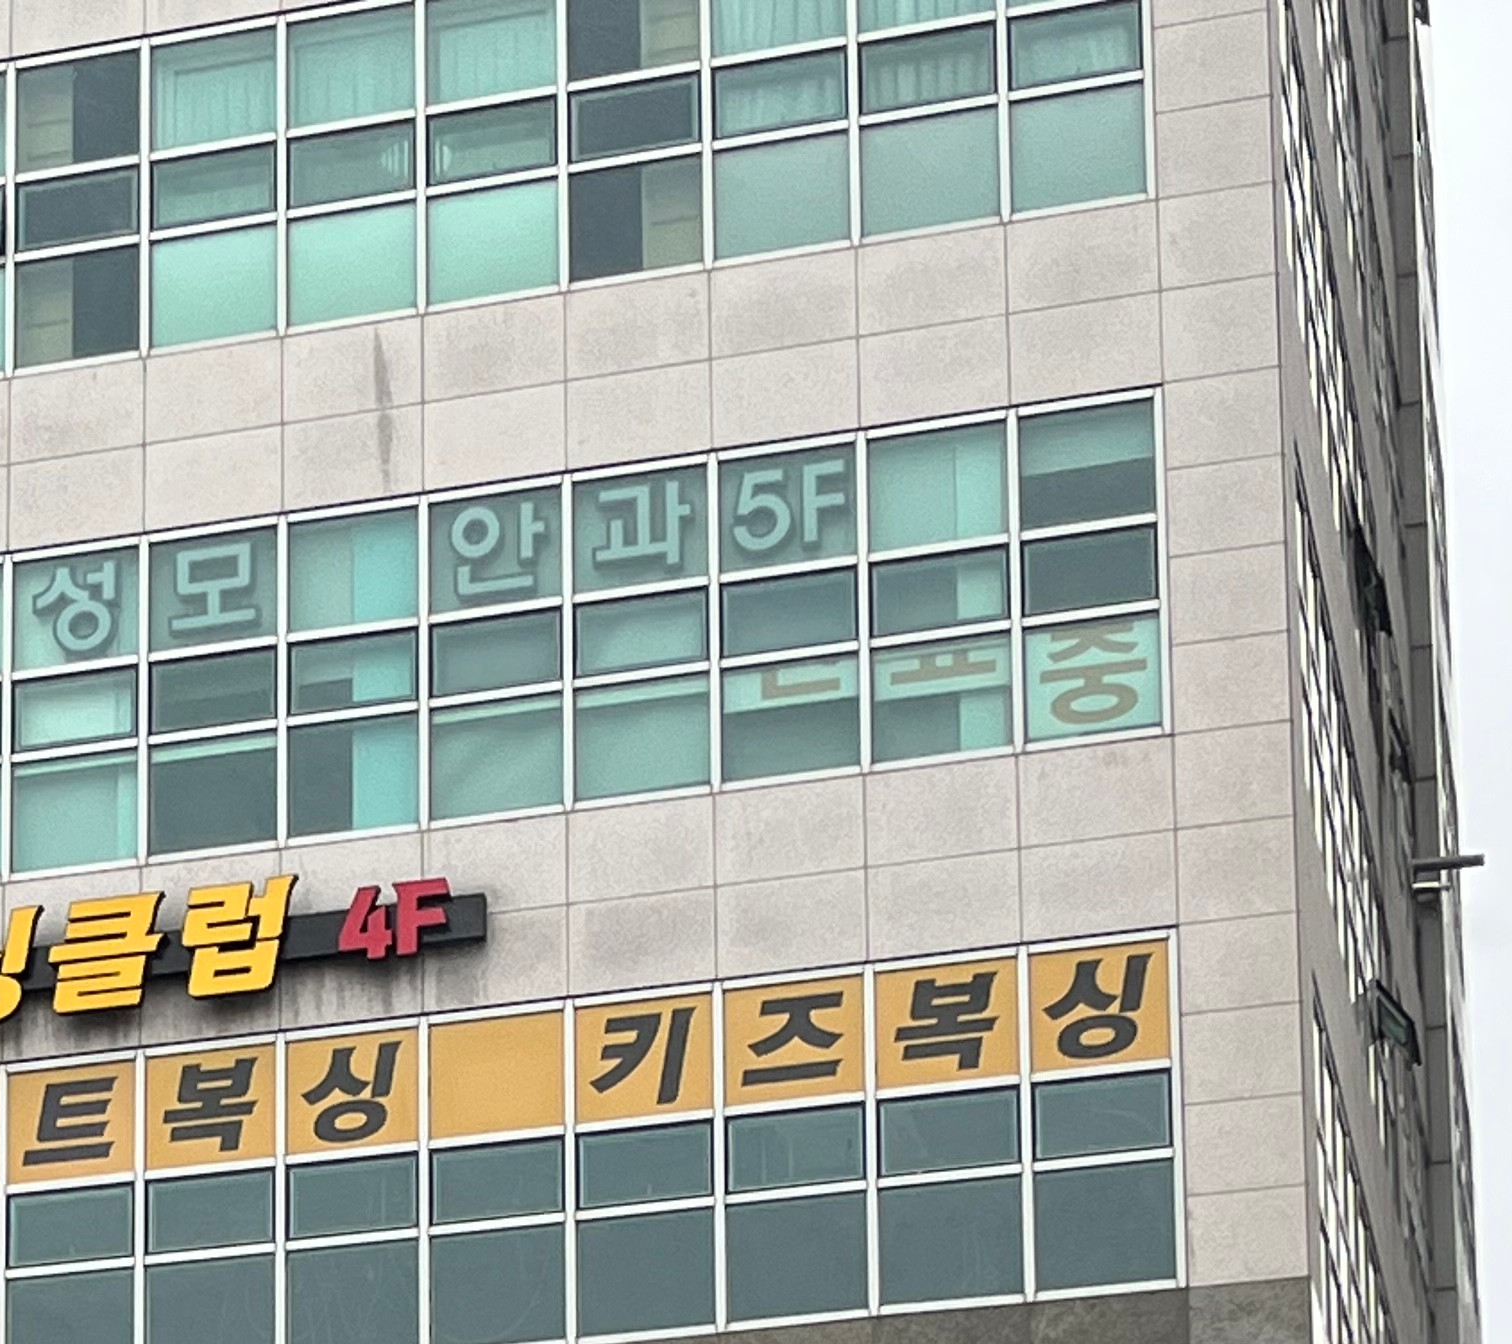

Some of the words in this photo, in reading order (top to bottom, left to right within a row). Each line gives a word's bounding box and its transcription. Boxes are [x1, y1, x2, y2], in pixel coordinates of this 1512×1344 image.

[33, 541, 263, 660] 성모
[450, 480, 693, 598] 안과
[732, 457, 847, 555] 5F
[337, 876, 454, 963] 4F
[589, 951, 1156, 1107] 키즈복싱
